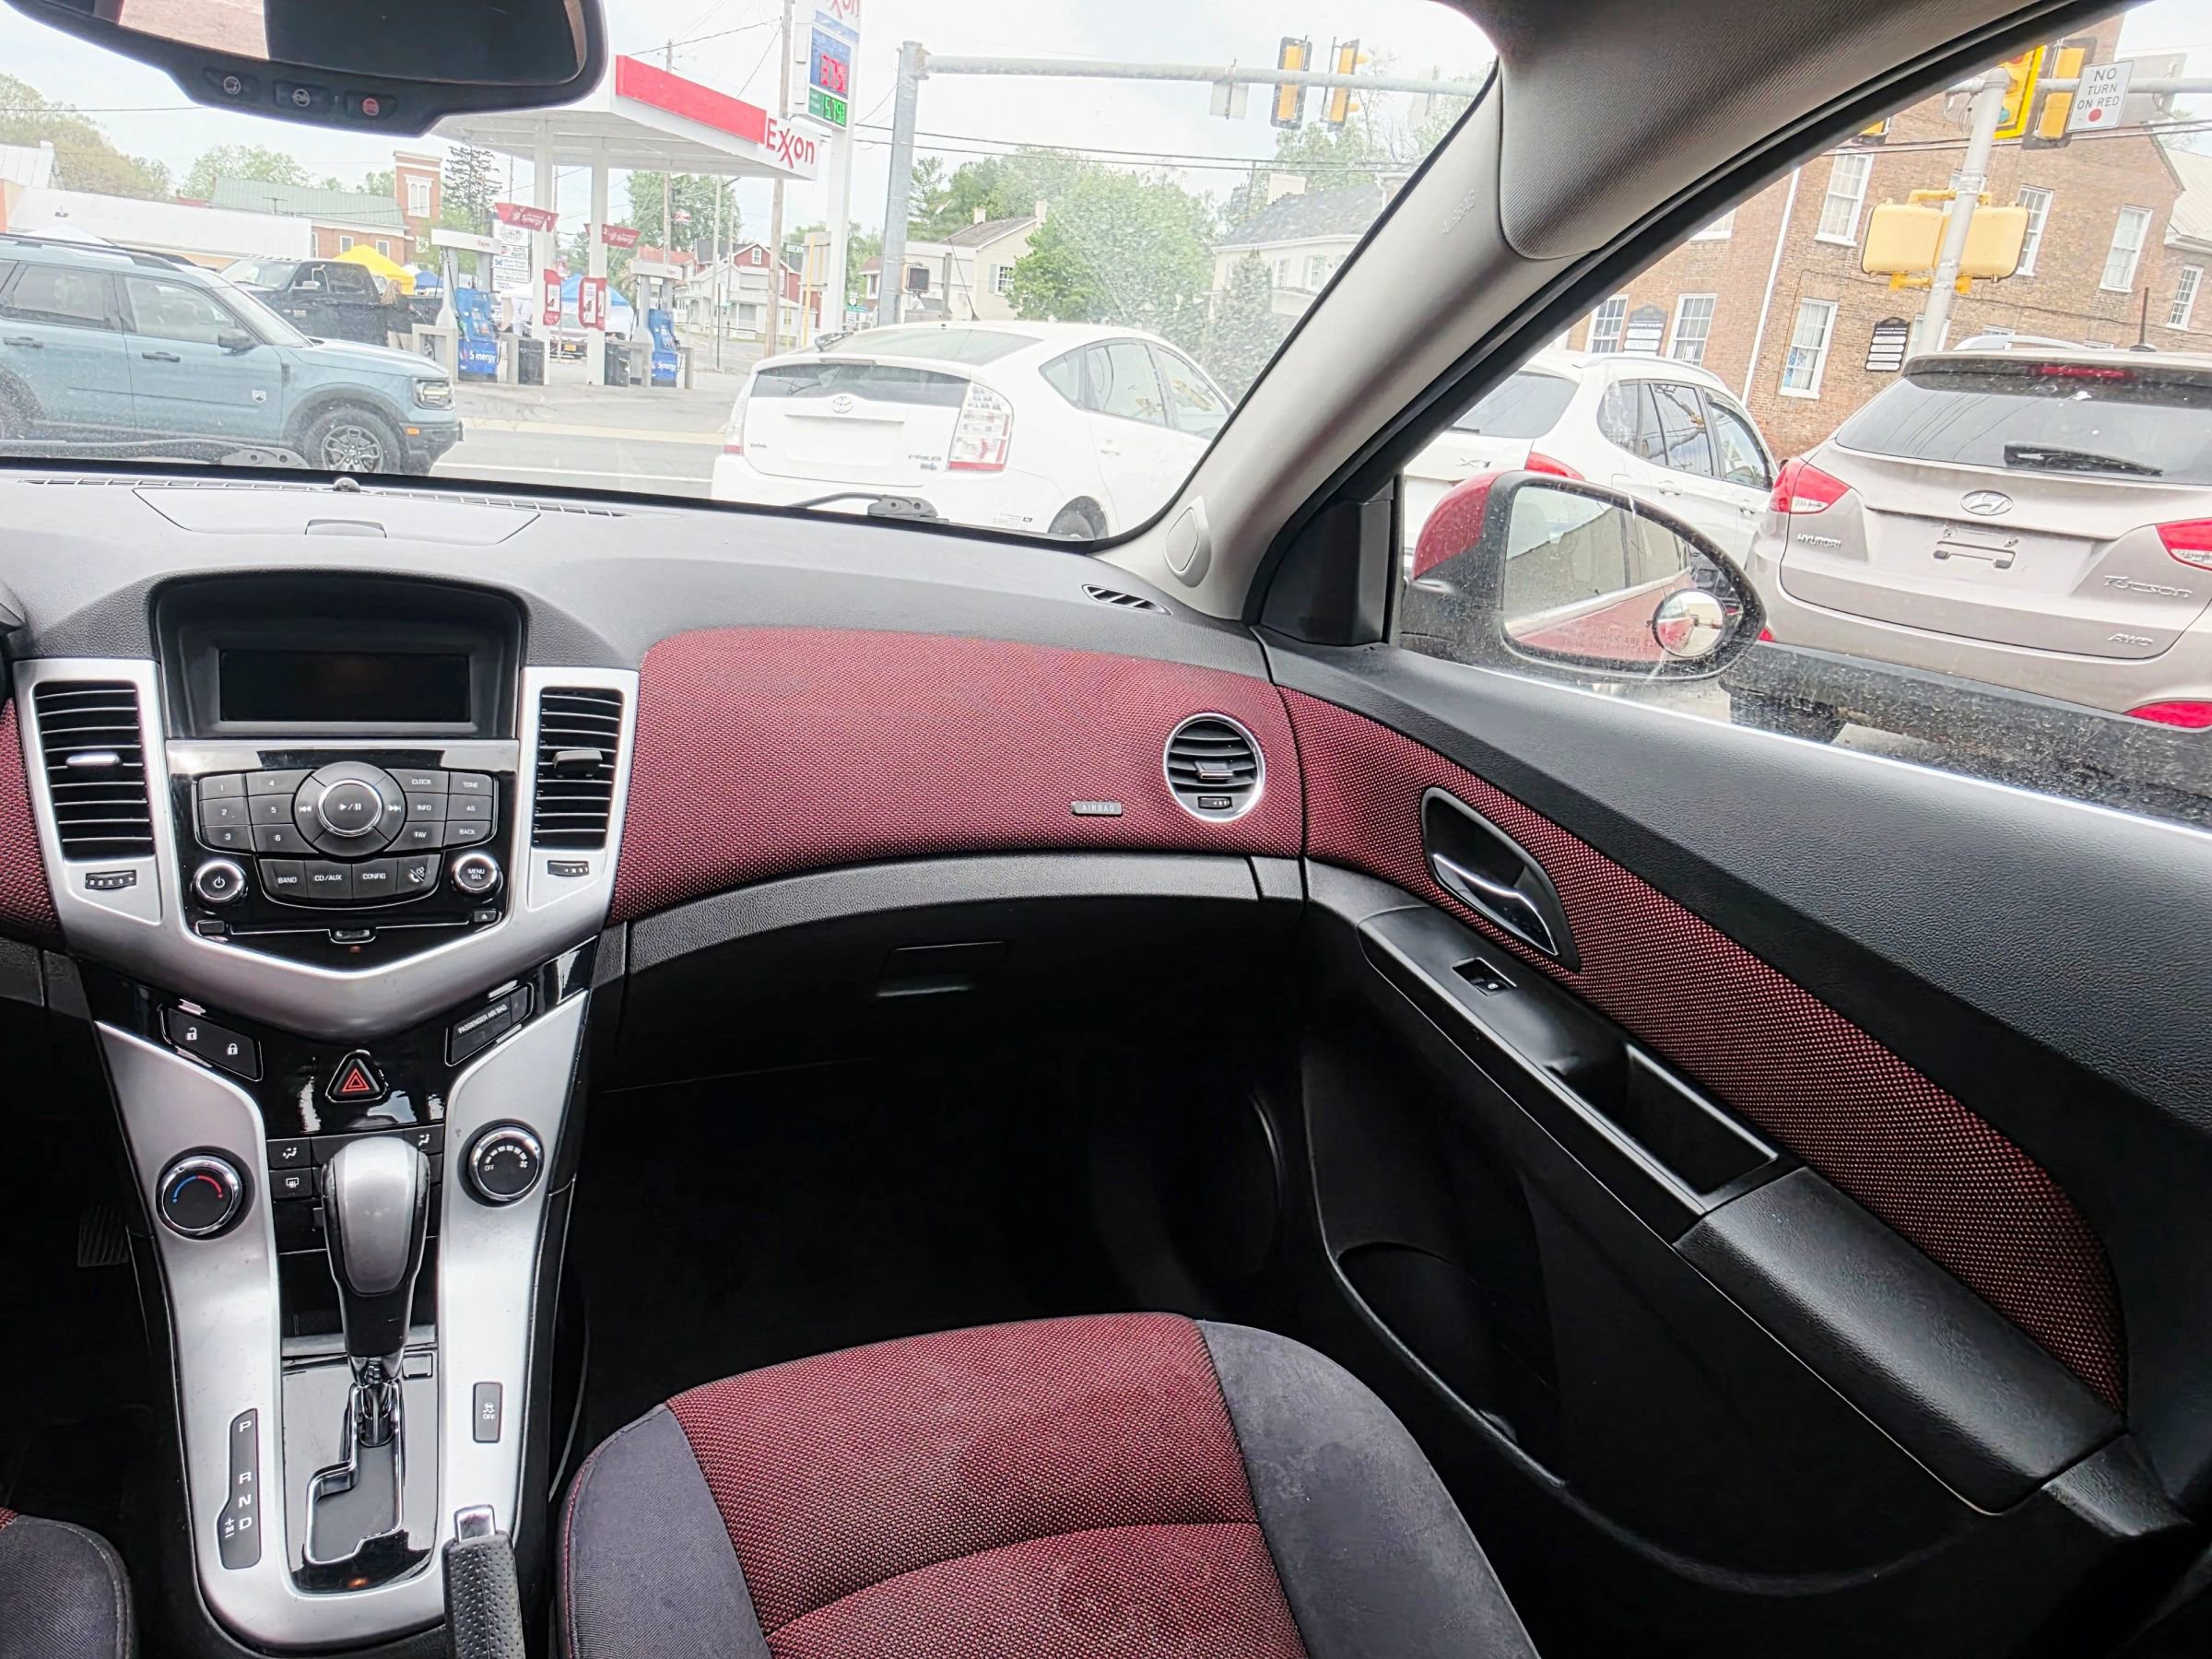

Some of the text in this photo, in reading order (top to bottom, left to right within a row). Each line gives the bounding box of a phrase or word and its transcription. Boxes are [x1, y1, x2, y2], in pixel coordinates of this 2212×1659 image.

[2094, 67, 2117, 81] NO
[2088, 83, 2118, 96] TURN
[2077, 96, 2120, 110] ON RED
[766, 118, 815, 170] Exxon
[469, 350, 496, 363] Snergy
[1797, 533, 1841, 548] HYUNDAI
[1081, 803, 1115, 813] AIRBAG
[277, 877, 298, 885] BAND
[314, 874, 342, 882] CD/AUX
[362, 872, 387, 880] CONFIG
[457, 1004, 508, 1034] PASSENGER AIR BAG
[239, 1420, 252, 1433] P
[239, 1471, 252, 1485] R
[238, 1494, 252, 1509] N
[239, 1516, 253, 1531] D
